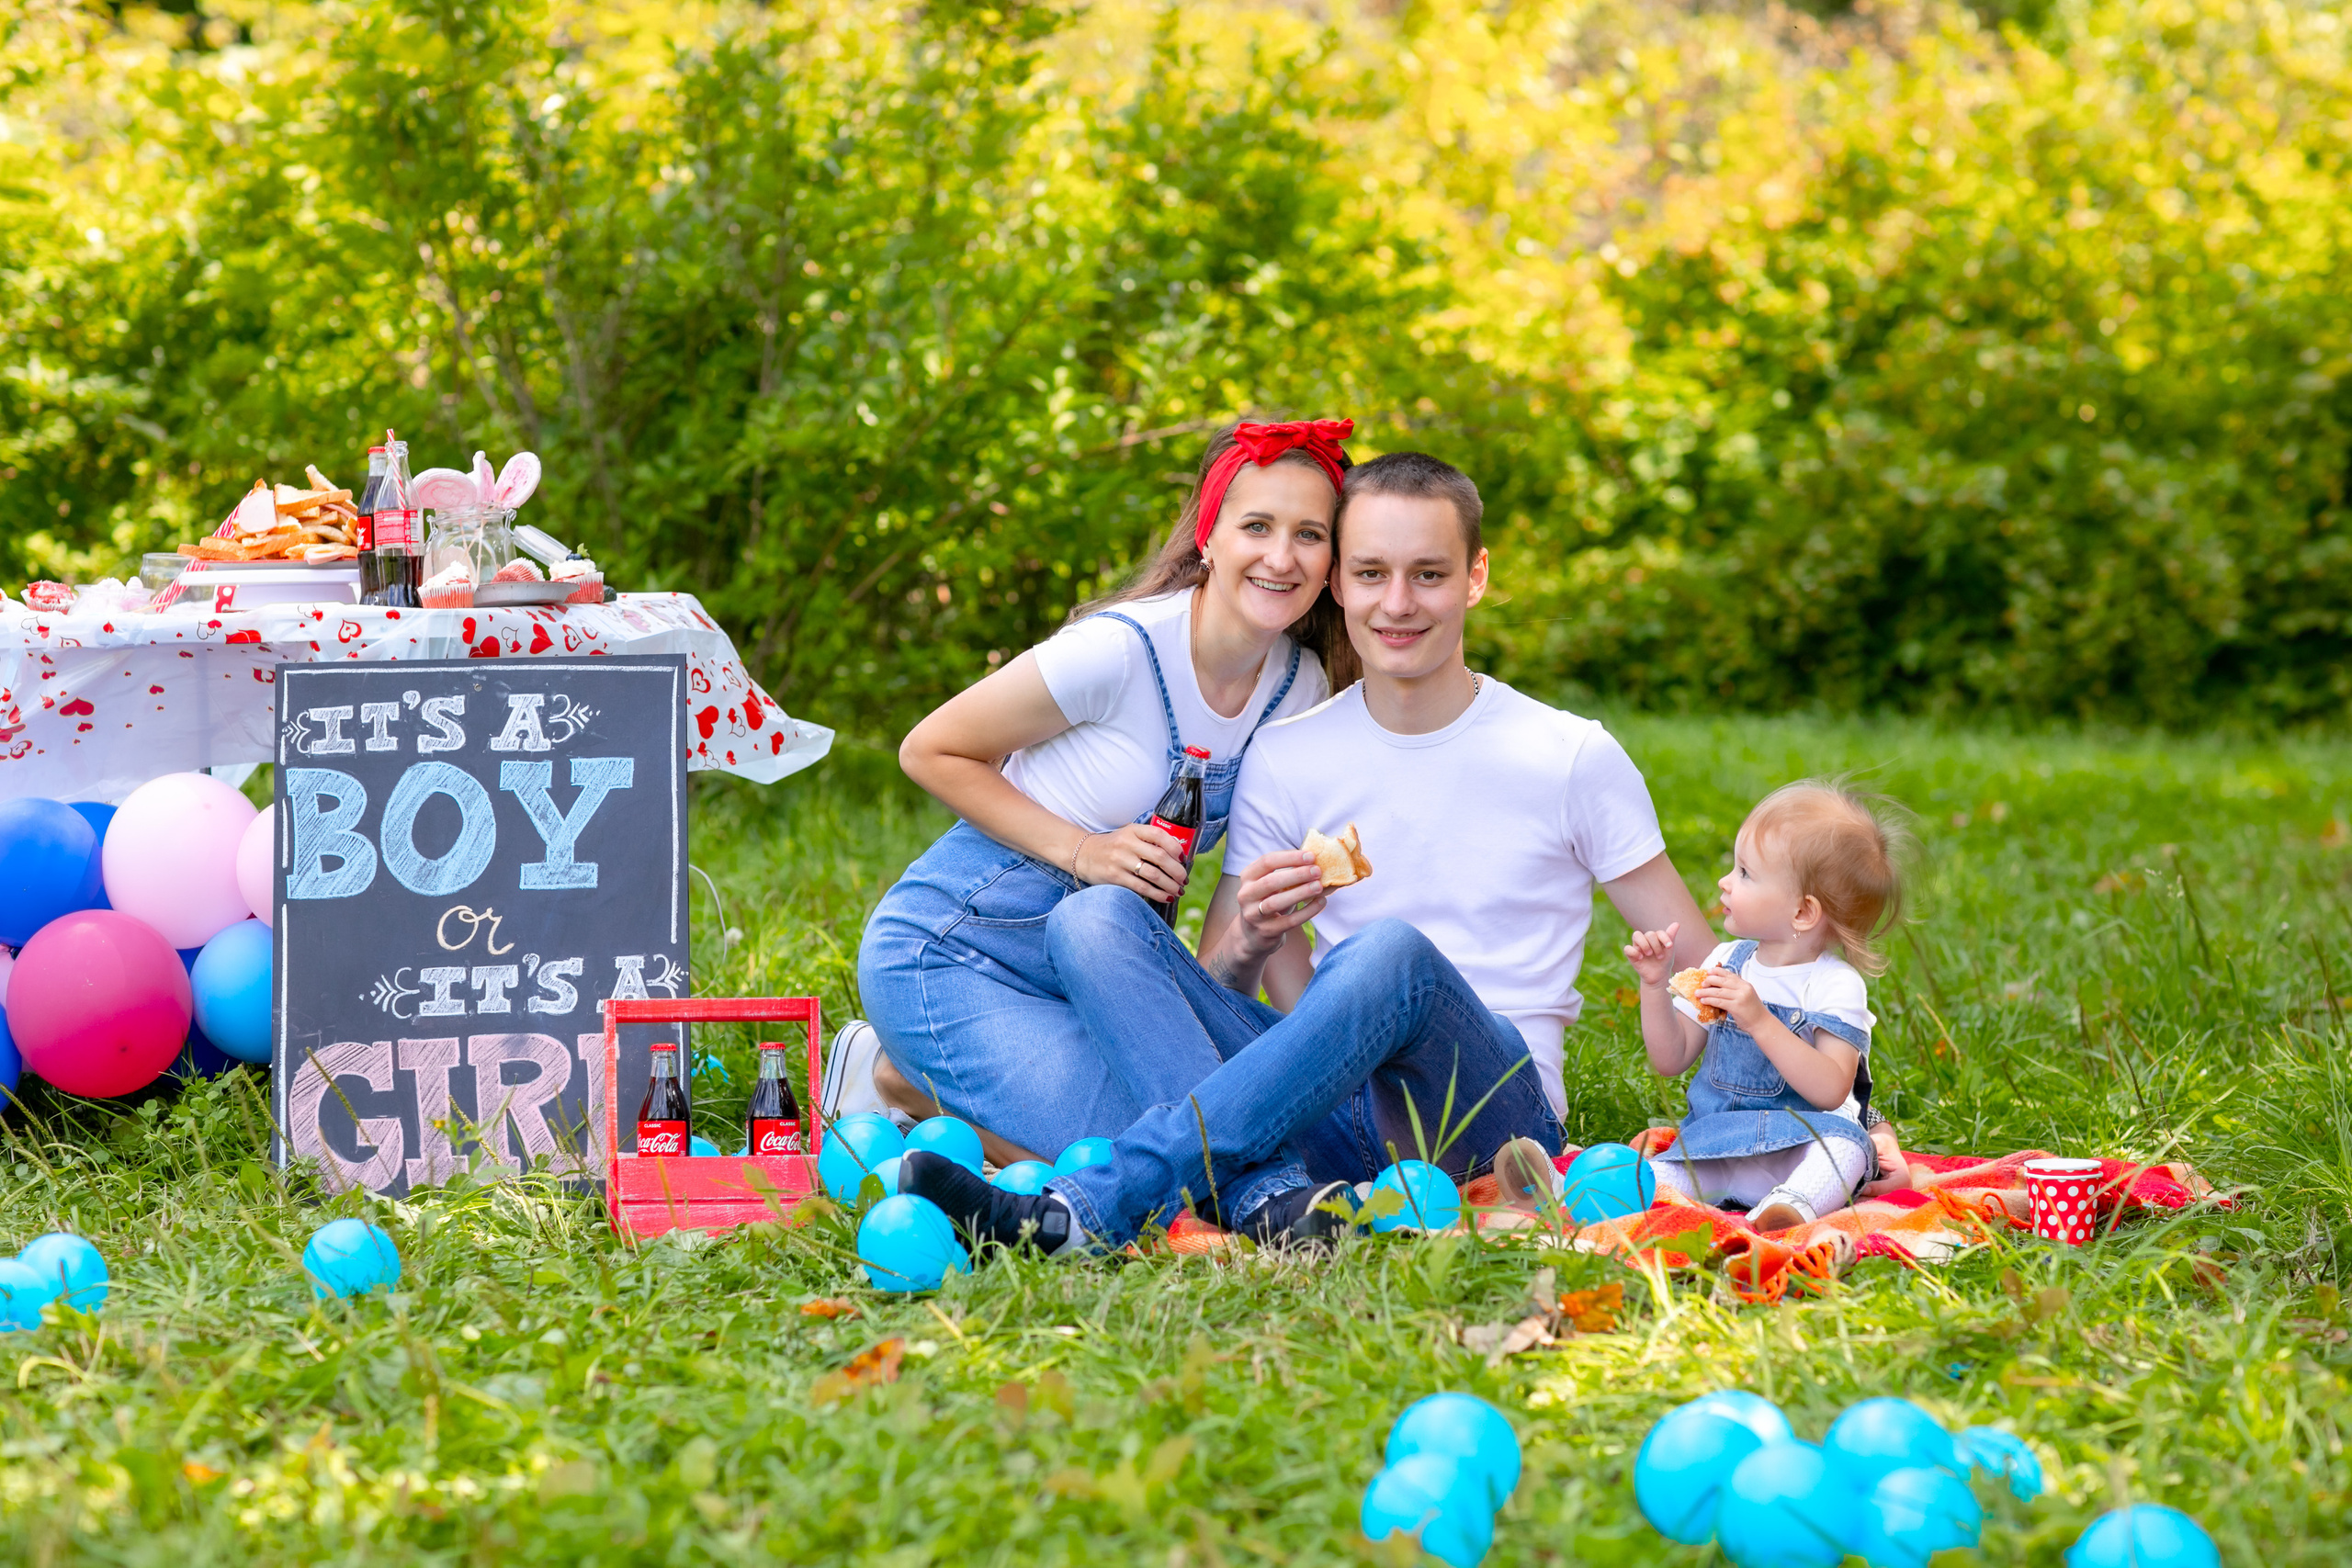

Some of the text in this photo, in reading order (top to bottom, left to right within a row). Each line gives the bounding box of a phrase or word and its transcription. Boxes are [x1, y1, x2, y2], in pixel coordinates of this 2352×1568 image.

[309, 690, 551, 753] IT'S A
[286, 758, 635, 900] BOY
[1156, 819, 1172, 829] CLASSIC
[419, 953, 651, 1017] IT'S A
